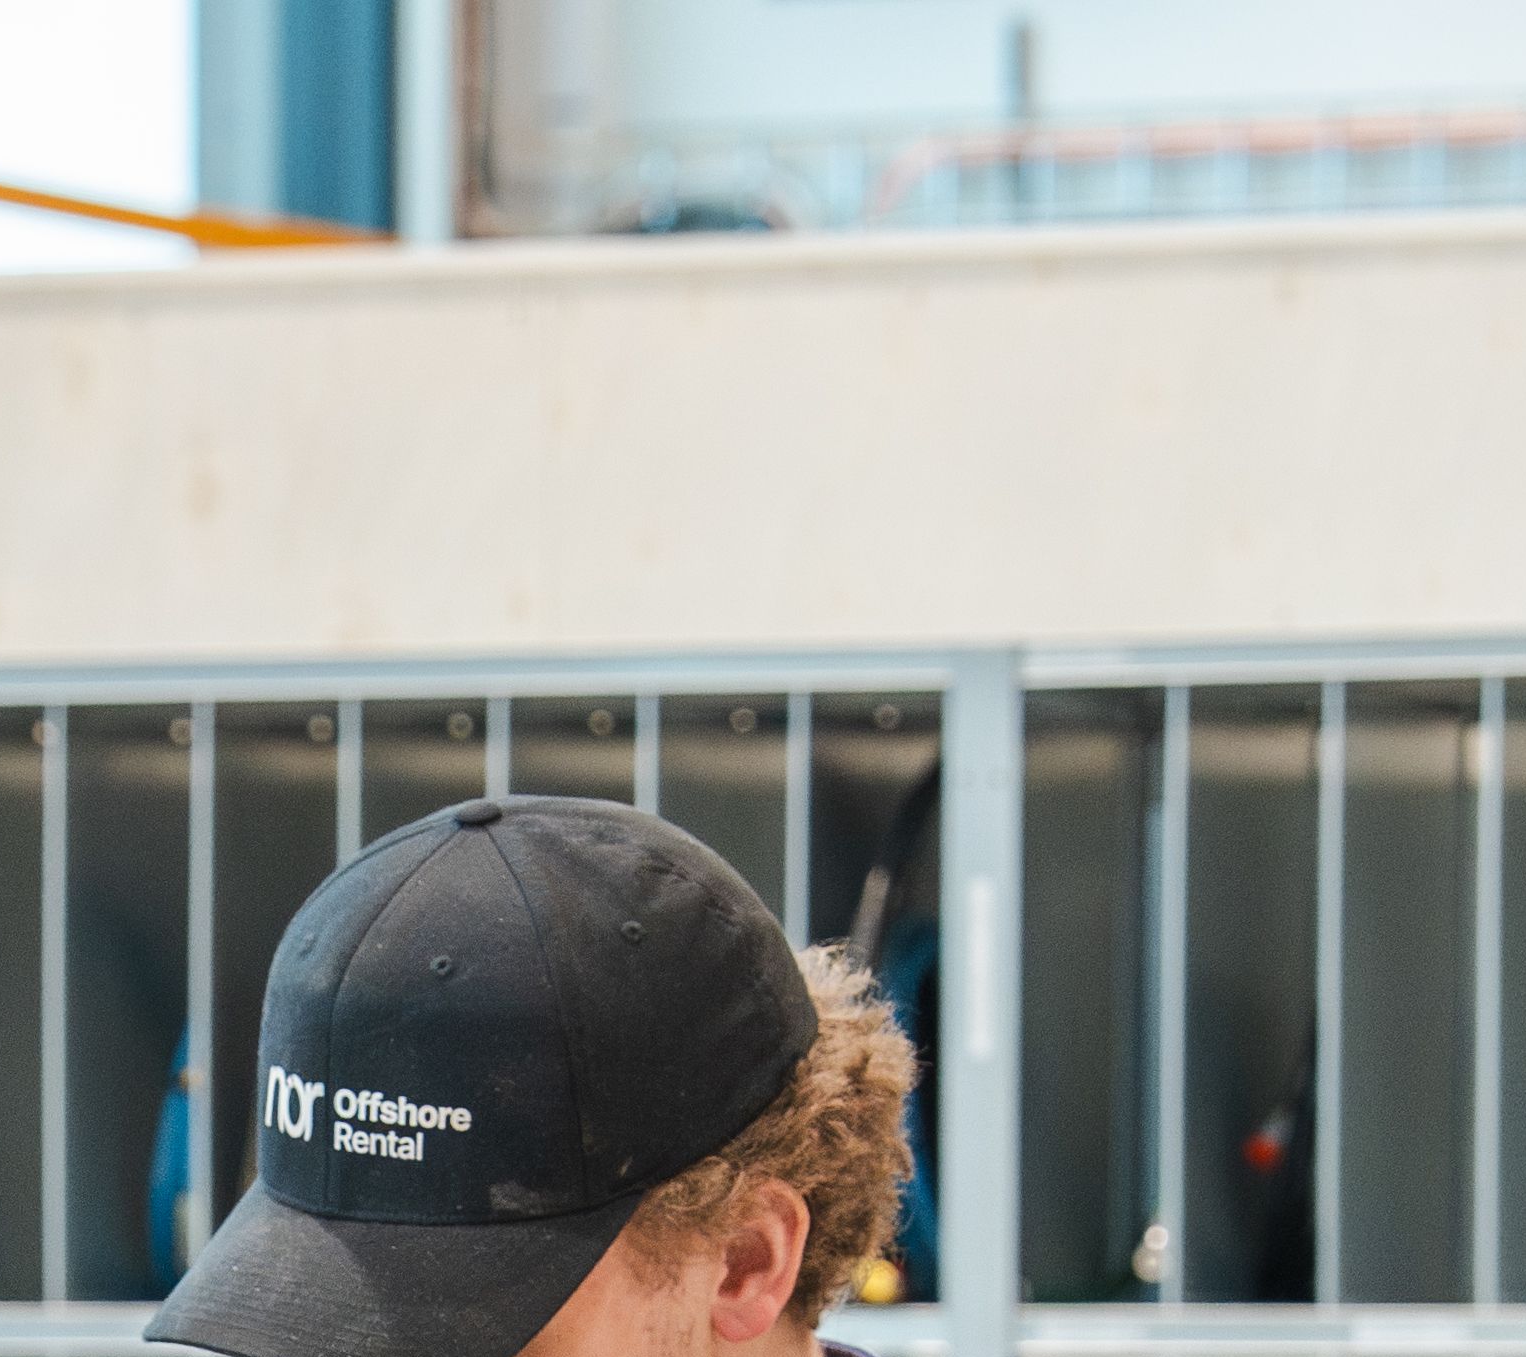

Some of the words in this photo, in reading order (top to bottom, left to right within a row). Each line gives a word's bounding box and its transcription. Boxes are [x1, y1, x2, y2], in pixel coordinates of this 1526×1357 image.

[264, 1065, 326, 1142] nor
[333, 1088, 472, 1132] Offshore
[333, 1121, 424, 1161] Rental
